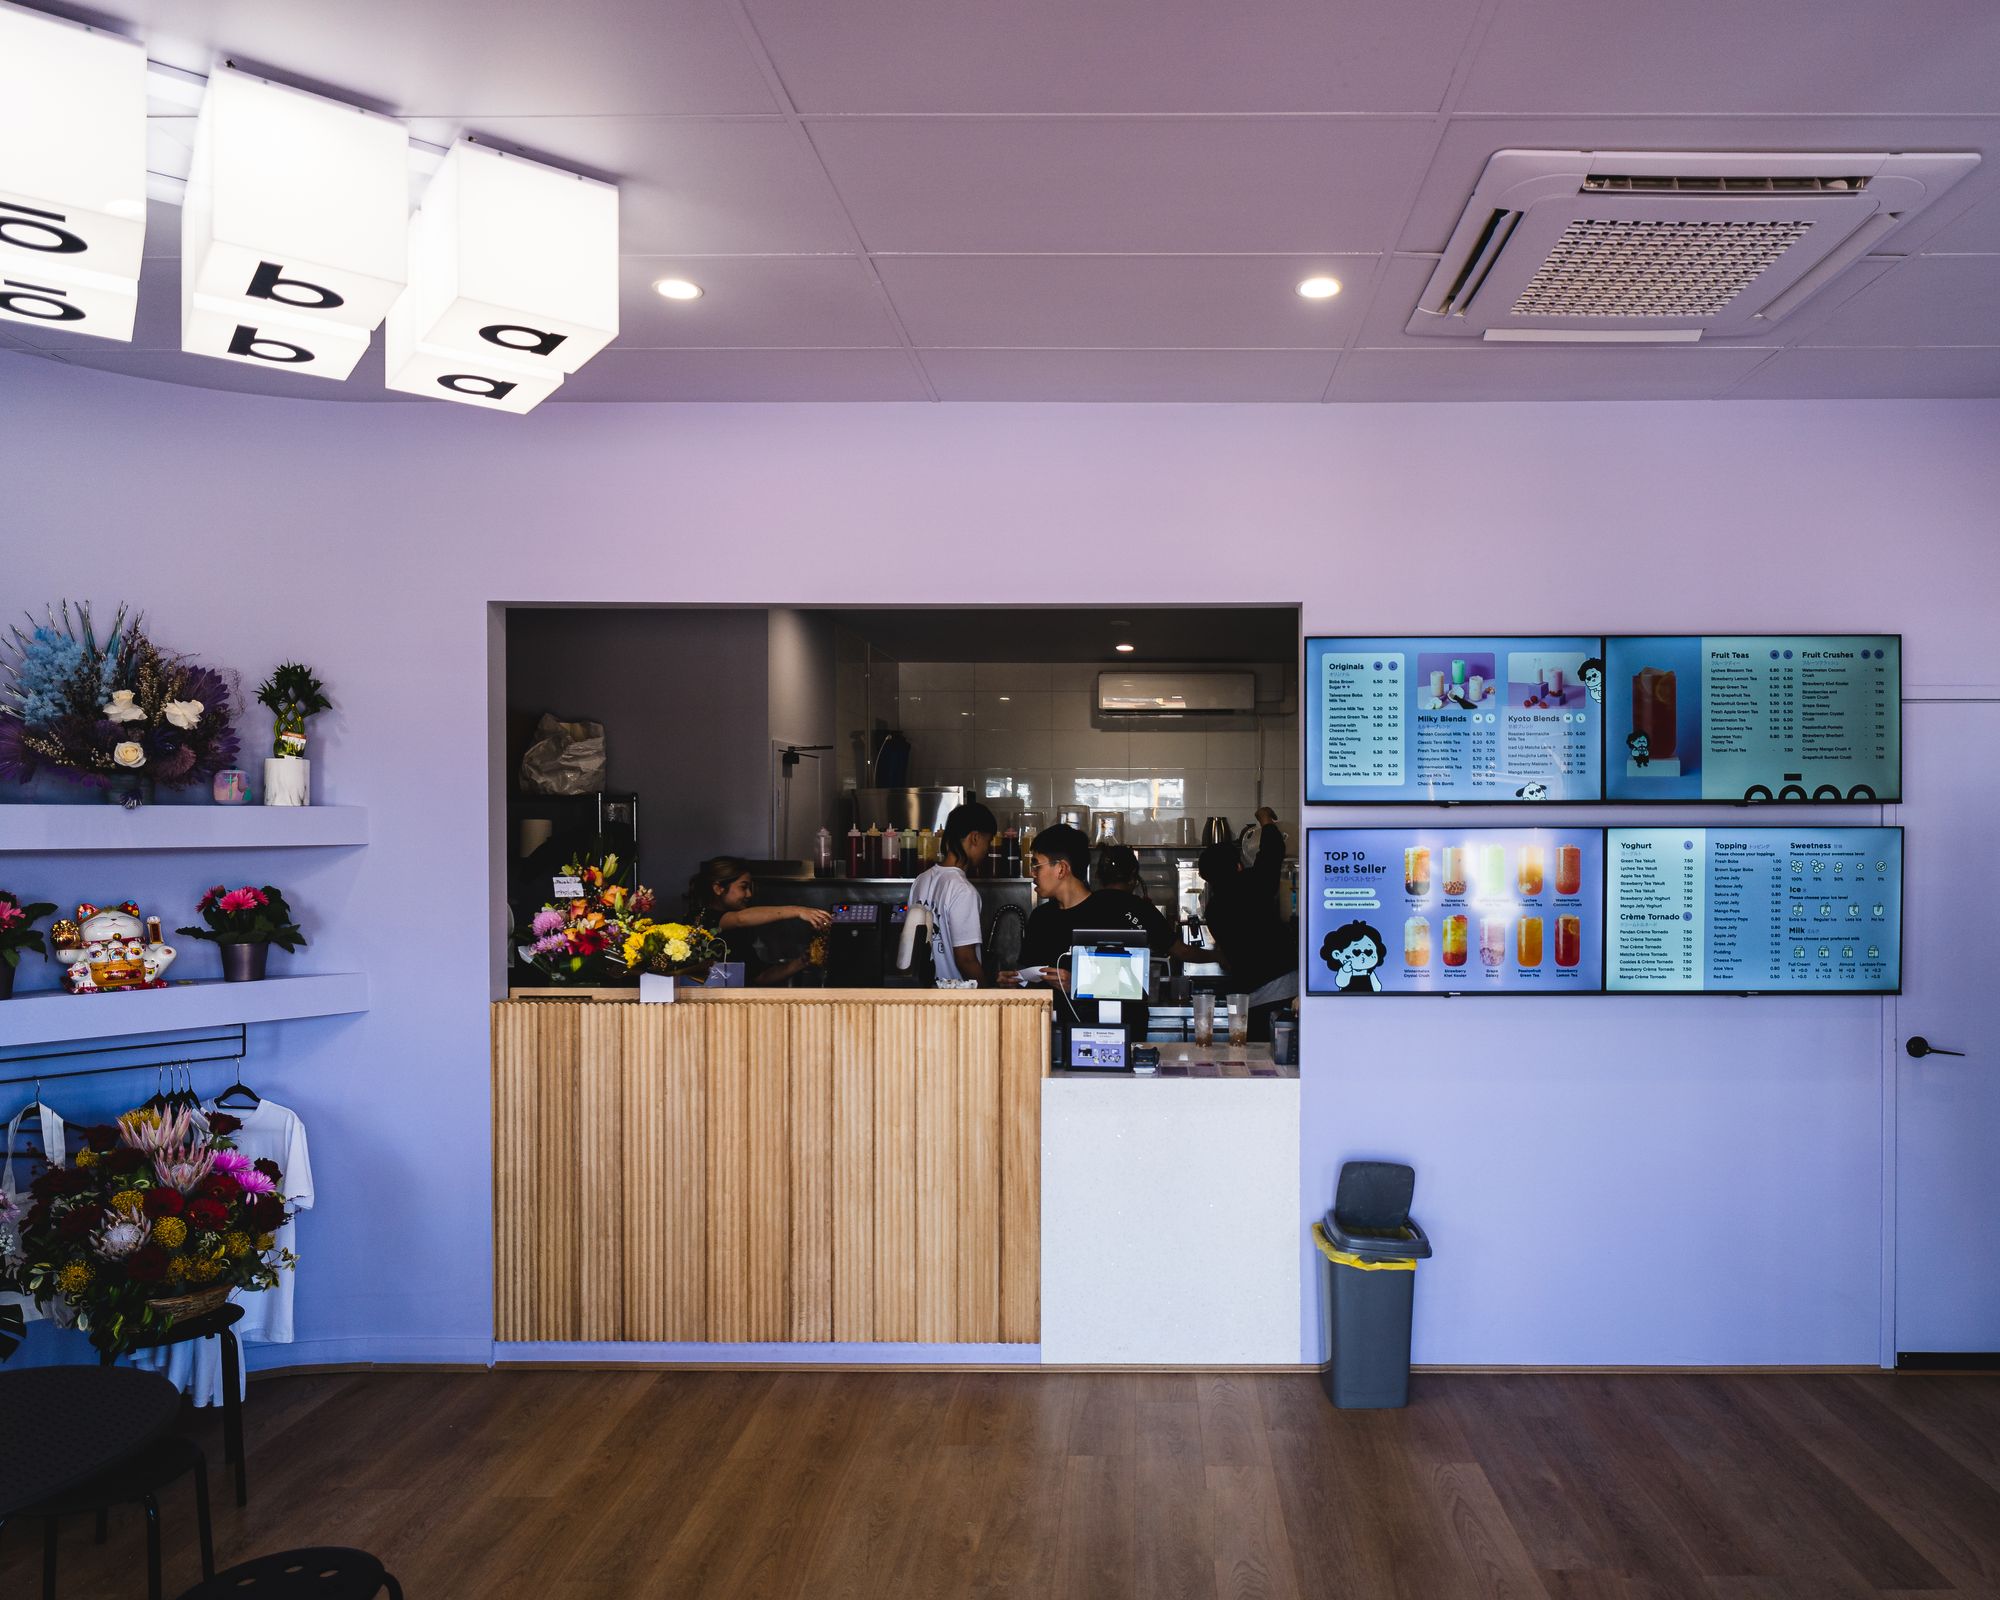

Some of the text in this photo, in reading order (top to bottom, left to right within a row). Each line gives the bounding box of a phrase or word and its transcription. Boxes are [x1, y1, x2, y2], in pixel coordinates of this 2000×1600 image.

[1329, 663, 1364, 671] Originals
[1417, 715, 1438, 723] Milky
[1507, 715, 1531, 723] Kyoto
[1621, 842, 1652, 850] Yoghurt
[1715, 842, 1747, 850] Topping
[1324, 851, 1365, 861] TOP 10
[1323, 864, 1387, 873] Best Seller
